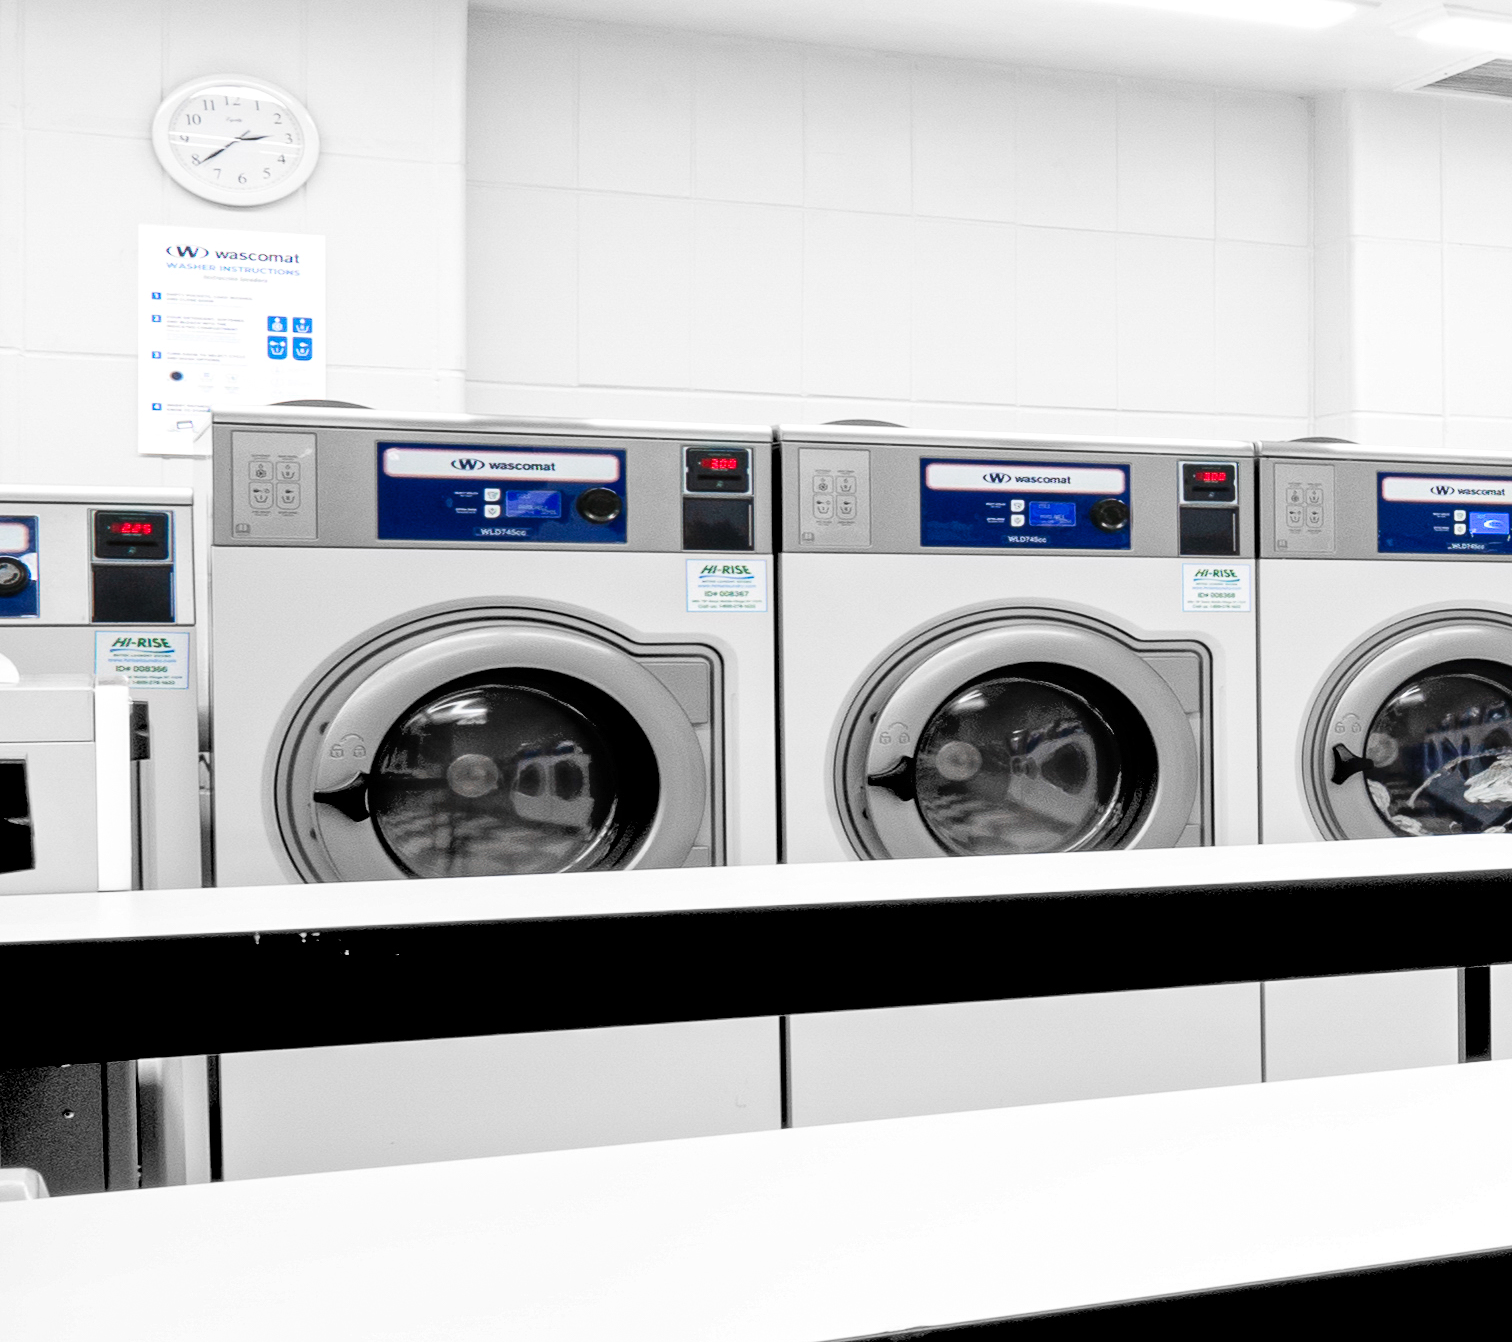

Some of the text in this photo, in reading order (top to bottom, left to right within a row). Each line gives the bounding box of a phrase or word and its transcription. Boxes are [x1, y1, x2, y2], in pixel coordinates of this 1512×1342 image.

[203, 99, 215, 111] 11
[255, 100, 260, 111] 1
[186, 114, 201, 125] 10
[274, 113, 282, 124] 2
[285, 133, 293, 144] 3
[192, 154, 200, 166] 8
[277, 154, 286, 164] 4
[213, 168, 221, 180] 7
[238, 173, 247, 184] 6
[263, 168, 271, 179] 5
[215, 250, 300, 264] wascomat
[167, 262, 300, 276] WASHER INSTRUCTIONS
[489, 461, 556, 471] wascomat
[1015, 476, 1071, 484] wascomat
[1458, 488, 1506, 496] wascomat
[701, 565, 752, 575] HI-RISE
[1195, 569, 1237, 578] HI-RISE
[112, 637, 171, 648] HI-RISE
[133, 665, 168, 673] 008366
